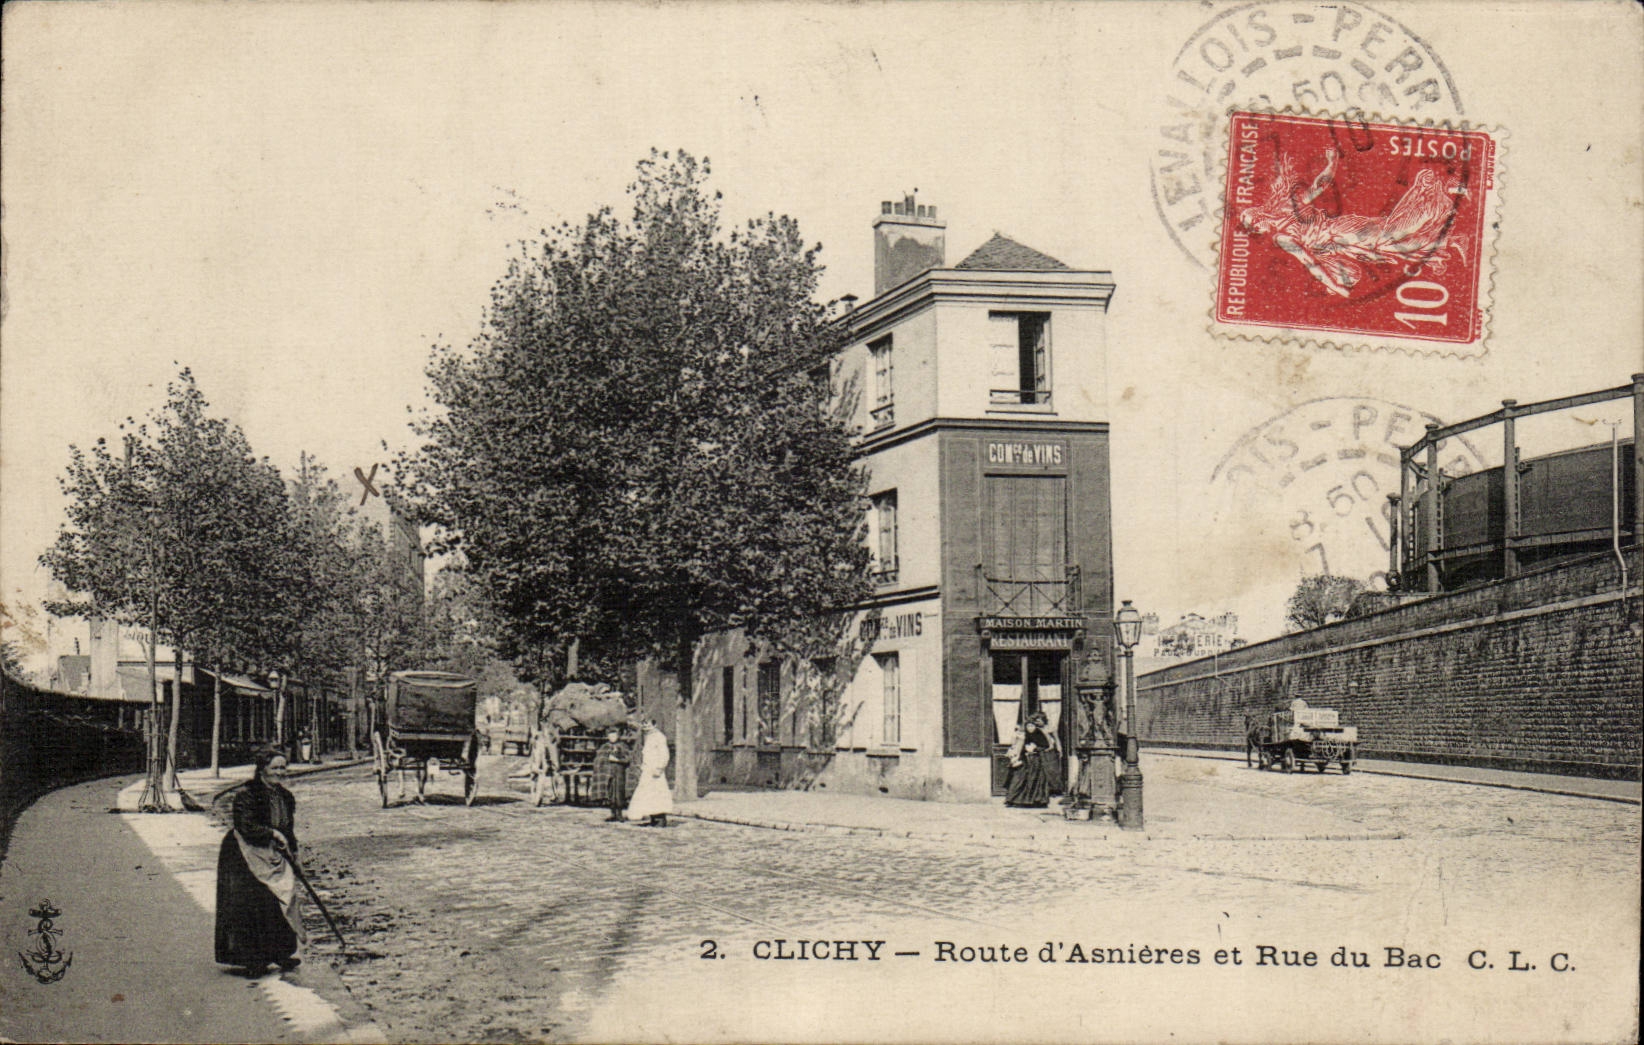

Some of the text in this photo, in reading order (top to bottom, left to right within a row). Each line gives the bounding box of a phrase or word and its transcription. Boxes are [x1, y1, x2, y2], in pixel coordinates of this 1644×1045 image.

[1389, 135, 1473, 162] POSTES
[1236, 122, 1259, 204] FRANÇAISE
[1034, 445, 1062, 465] VINS
[896, 612, 922, 638] VINS
[985, 618, 1082, 628] MAISON MARTIN
[991, 632, 1068, 648] RESTAURANT
